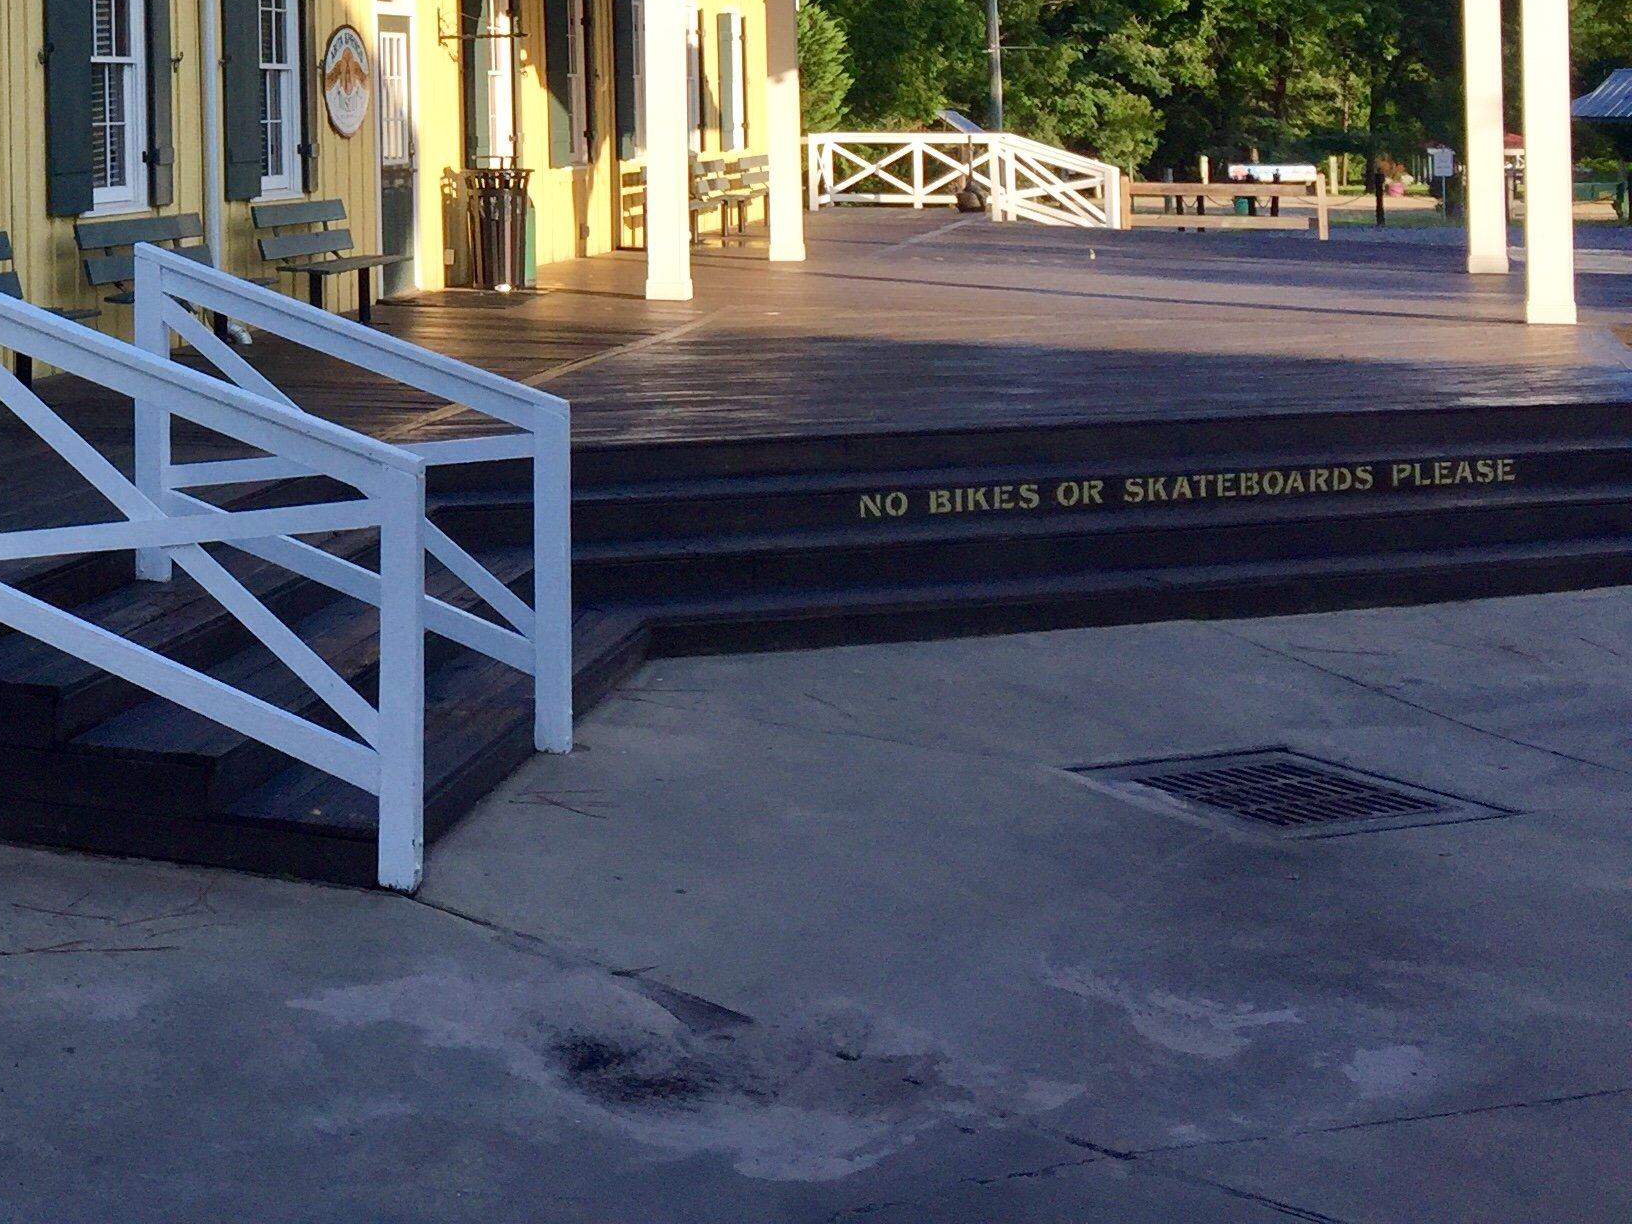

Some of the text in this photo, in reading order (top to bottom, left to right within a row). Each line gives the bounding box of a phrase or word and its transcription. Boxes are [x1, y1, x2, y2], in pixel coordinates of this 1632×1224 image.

[859, 457, 1517, 519] NO BIKES OR SKATEBOARDS PLEASE
